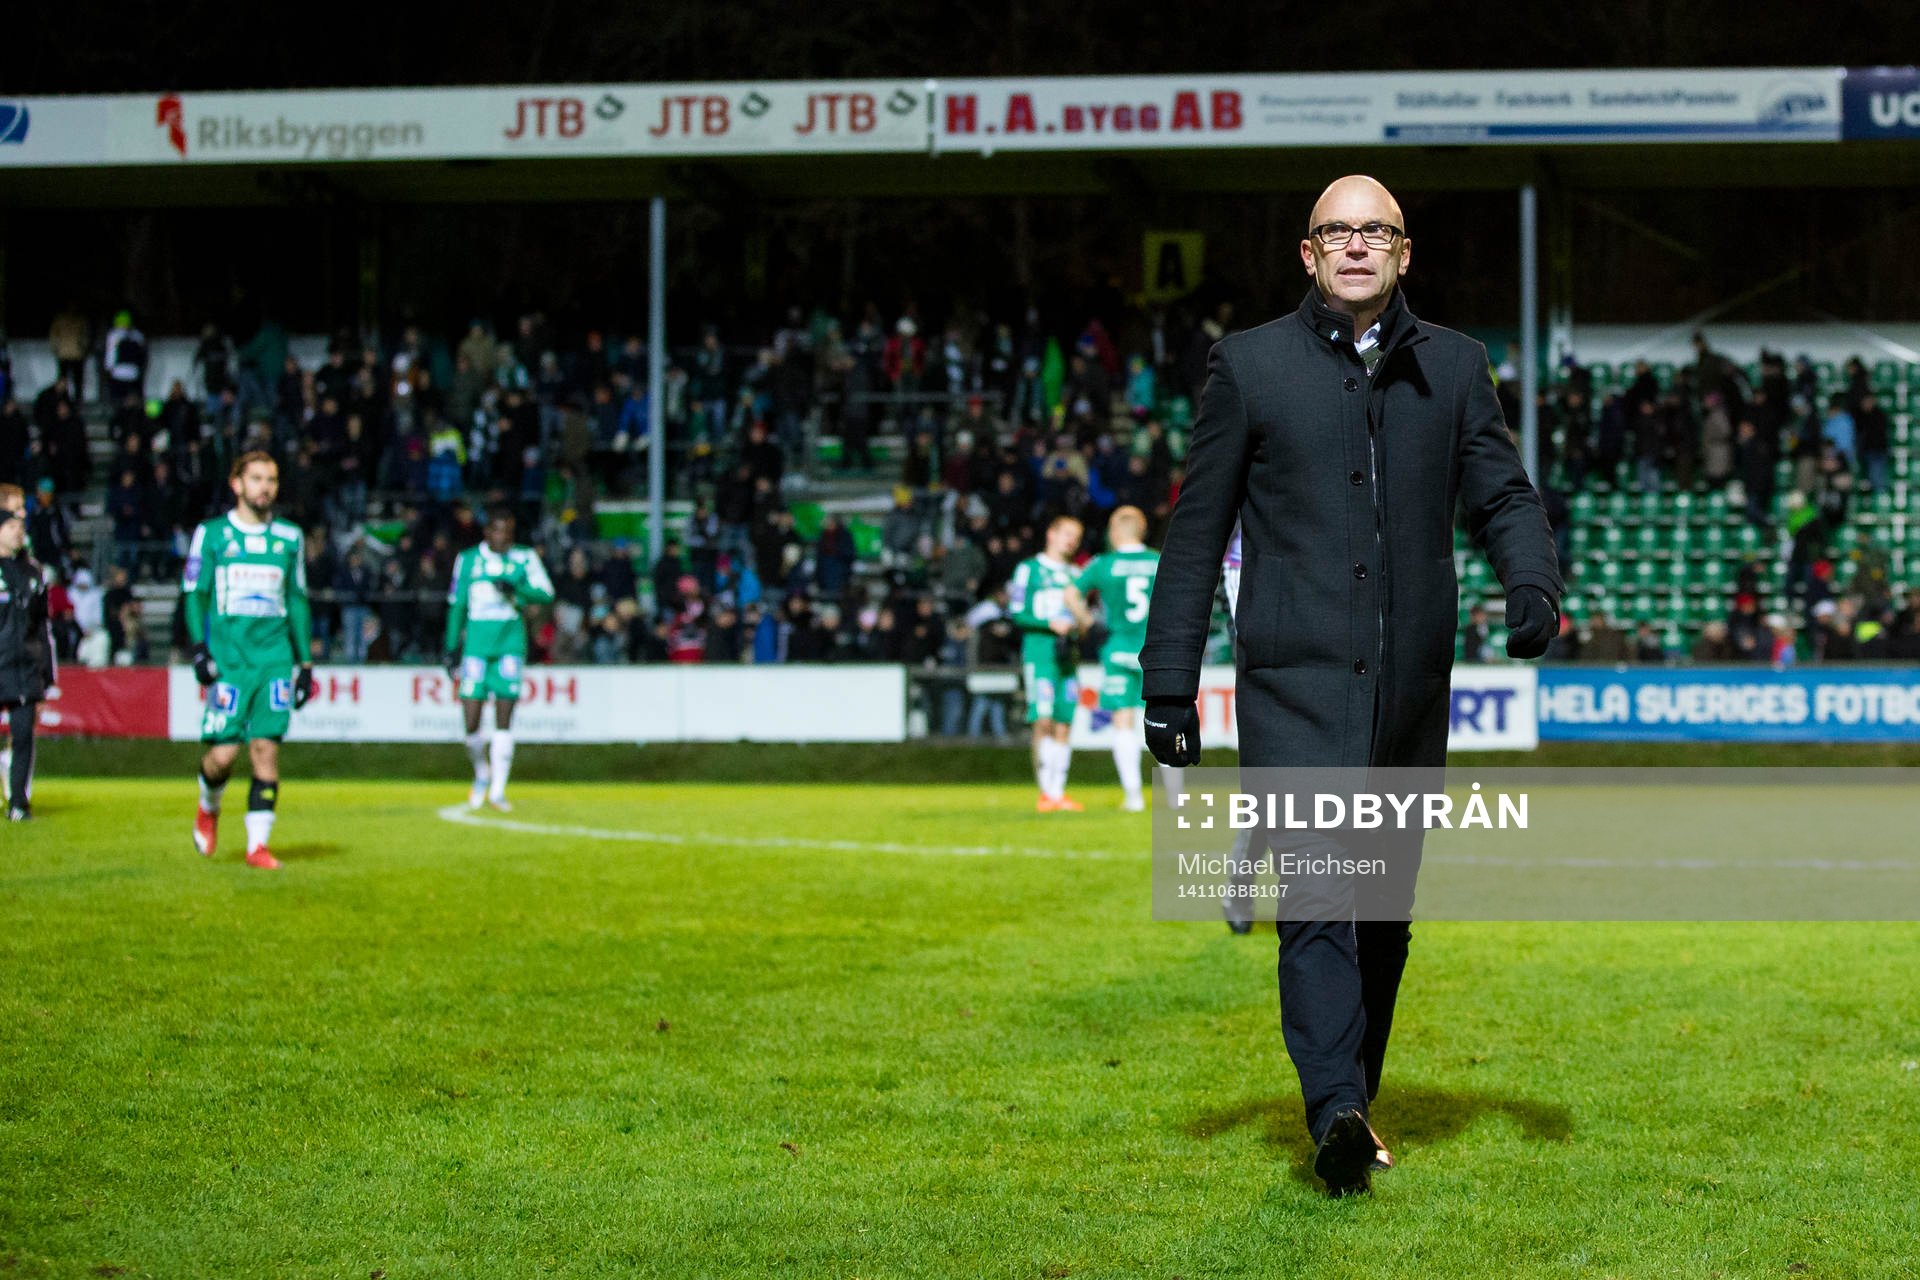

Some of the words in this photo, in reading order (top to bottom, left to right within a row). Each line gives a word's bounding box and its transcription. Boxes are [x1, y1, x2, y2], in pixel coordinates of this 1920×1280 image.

[504, 98, 586, 138] JTB
[648, 96, 731, 137] JTB
[793, 93, 878, 135] JTB
[1170, 90, 1243, 131] AB
[197, 115, 424, 160] Riksbyggen
[1157, 242, 1184, 289] A
[1124, 576, 1150, 623] 5
[1538, 684, 1630, 722] HELA
[1636, 684, 1809, 723] SVERIGES
